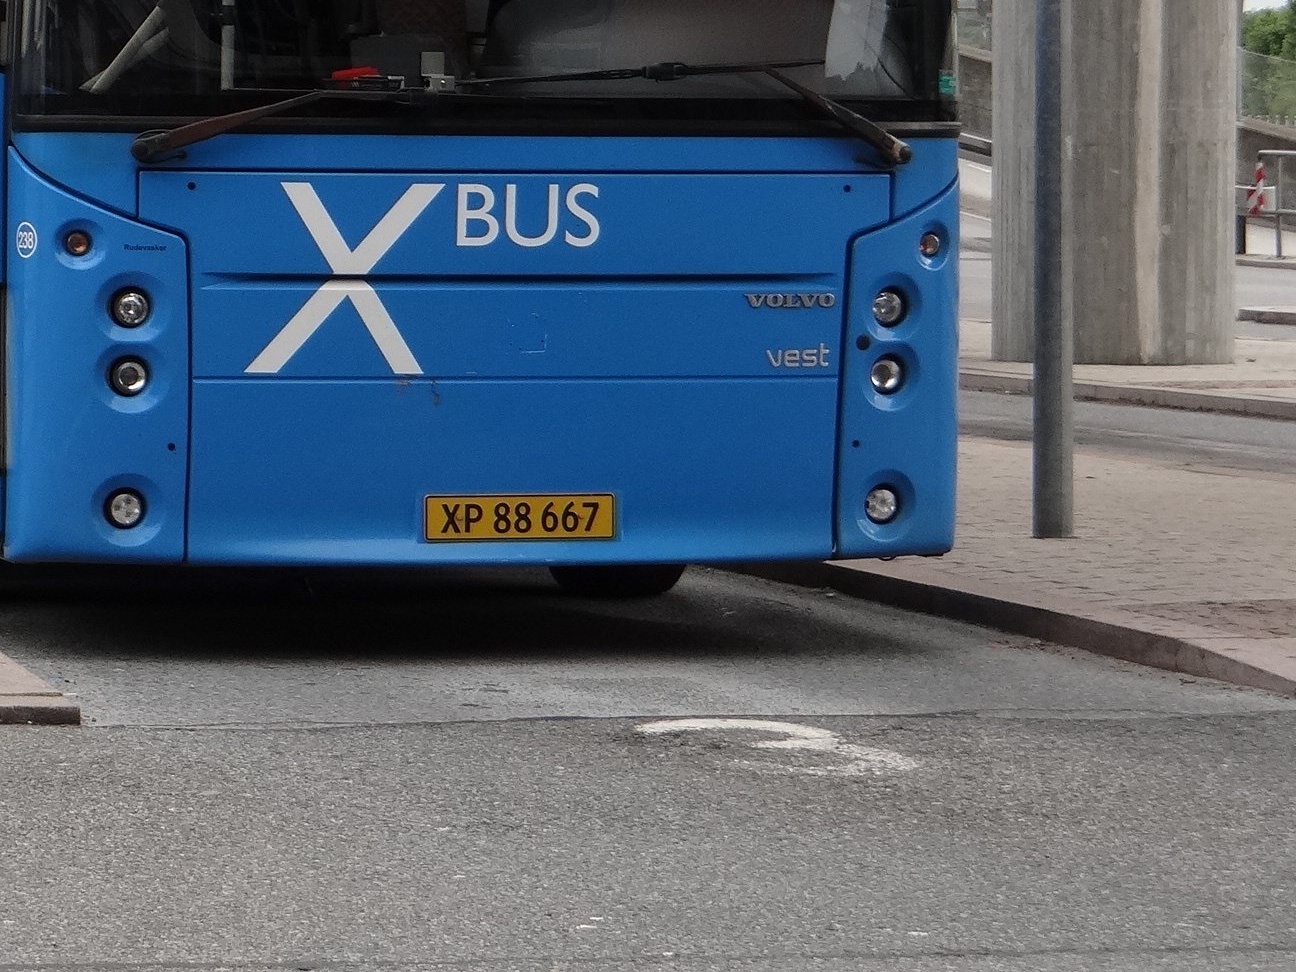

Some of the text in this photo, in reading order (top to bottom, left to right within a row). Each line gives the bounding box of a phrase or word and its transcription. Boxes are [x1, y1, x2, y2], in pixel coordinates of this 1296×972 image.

[455, 182, 601, 248] BUS
[18, 231, 34, 249] 238
[744, 292, 836, 309] VOLVO
[765, 342, 830, 368] vest
[440, 501, 600, 534] XP 88 667
